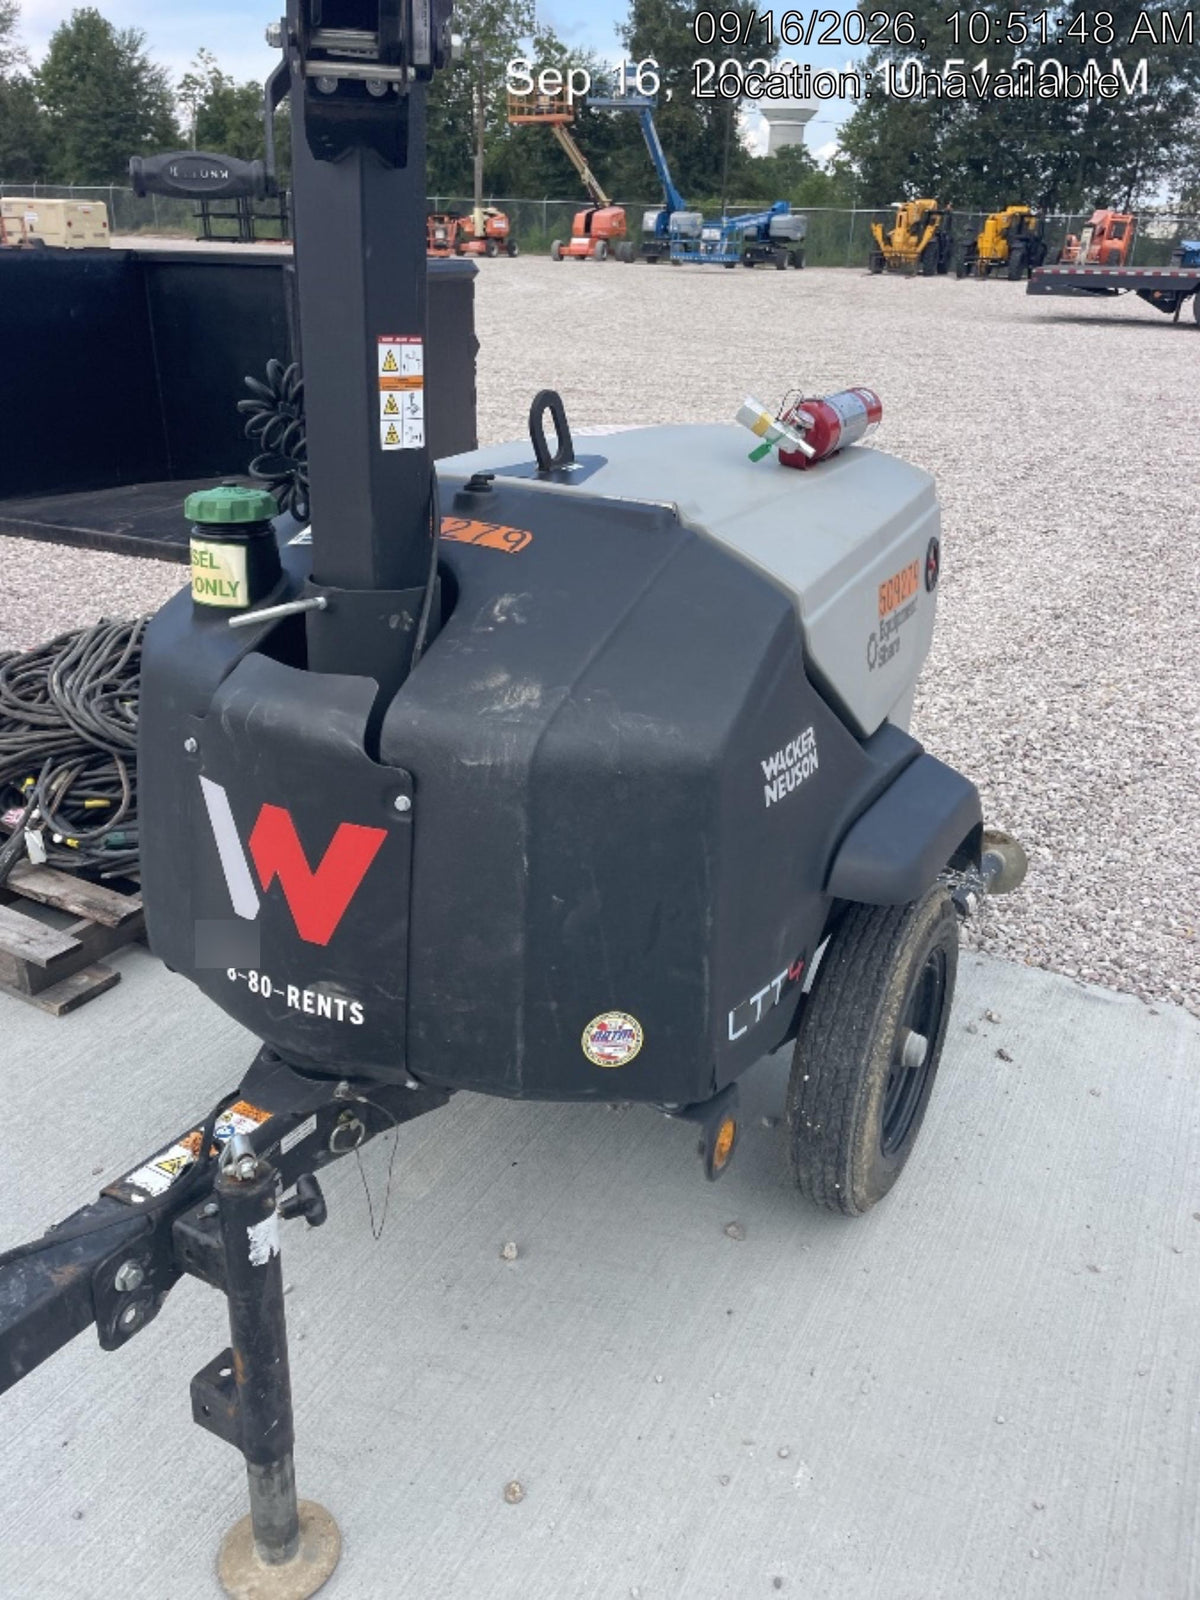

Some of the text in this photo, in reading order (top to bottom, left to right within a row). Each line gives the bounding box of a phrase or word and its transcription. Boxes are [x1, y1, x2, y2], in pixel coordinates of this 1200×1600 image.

[194, 577, 240, 598] ONLY
[761, 726, 816, 781] WACKER
[764, 748, 819, 808] NEUSON
